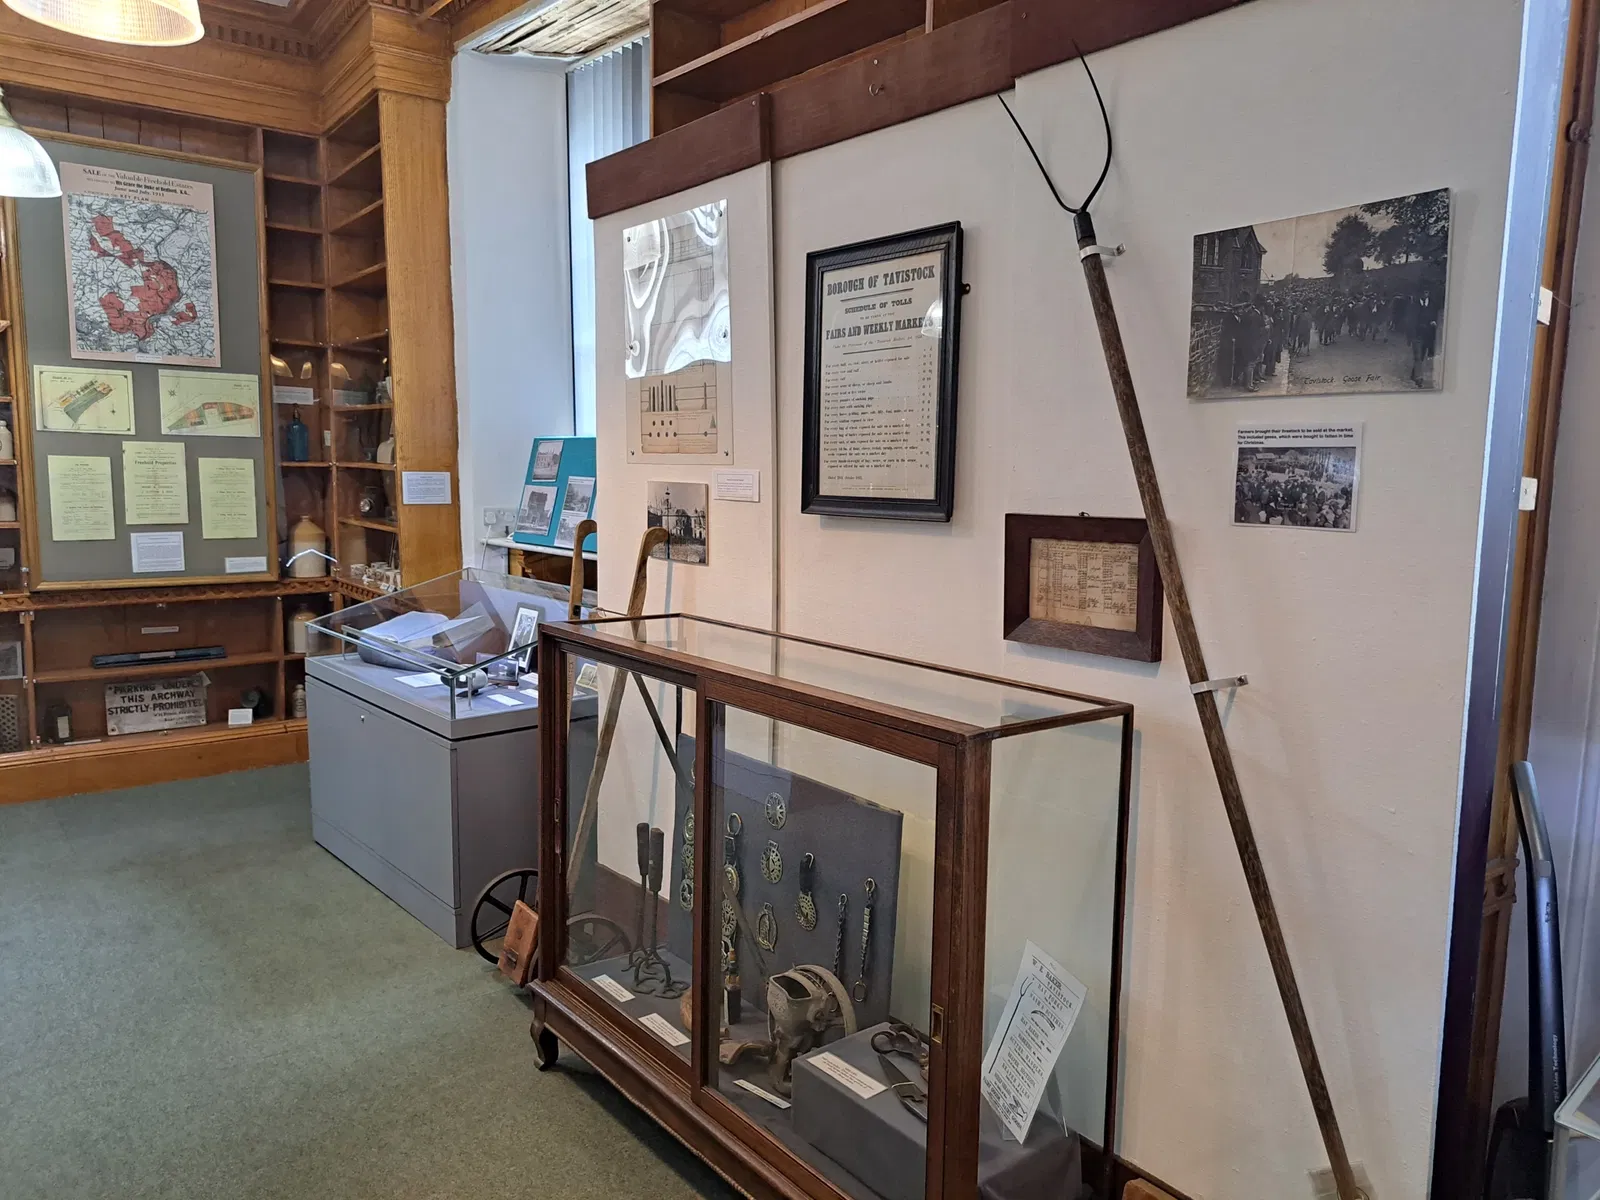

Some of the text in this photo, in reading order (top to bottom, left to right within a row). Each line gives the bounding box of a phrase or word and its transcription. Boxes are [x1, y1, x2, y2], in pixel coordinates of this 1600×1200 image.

[827, 265, 935, 296] BOROUGH OF TAVISTOCK
[845, 303, 876, 314] SCHEDULE
[891, 298, 913, 307] TOLLS
[826, 316, 934, 340] FAIRS AND WEEKLY MARKETS
[1342, 376, 1361, 384] Goose
[114, 680, 199, 694] PARKING UNDER
[120, 690, 196, 704] THIS ARCHWAY
[108, 704, 149, 715] STRICTLY
